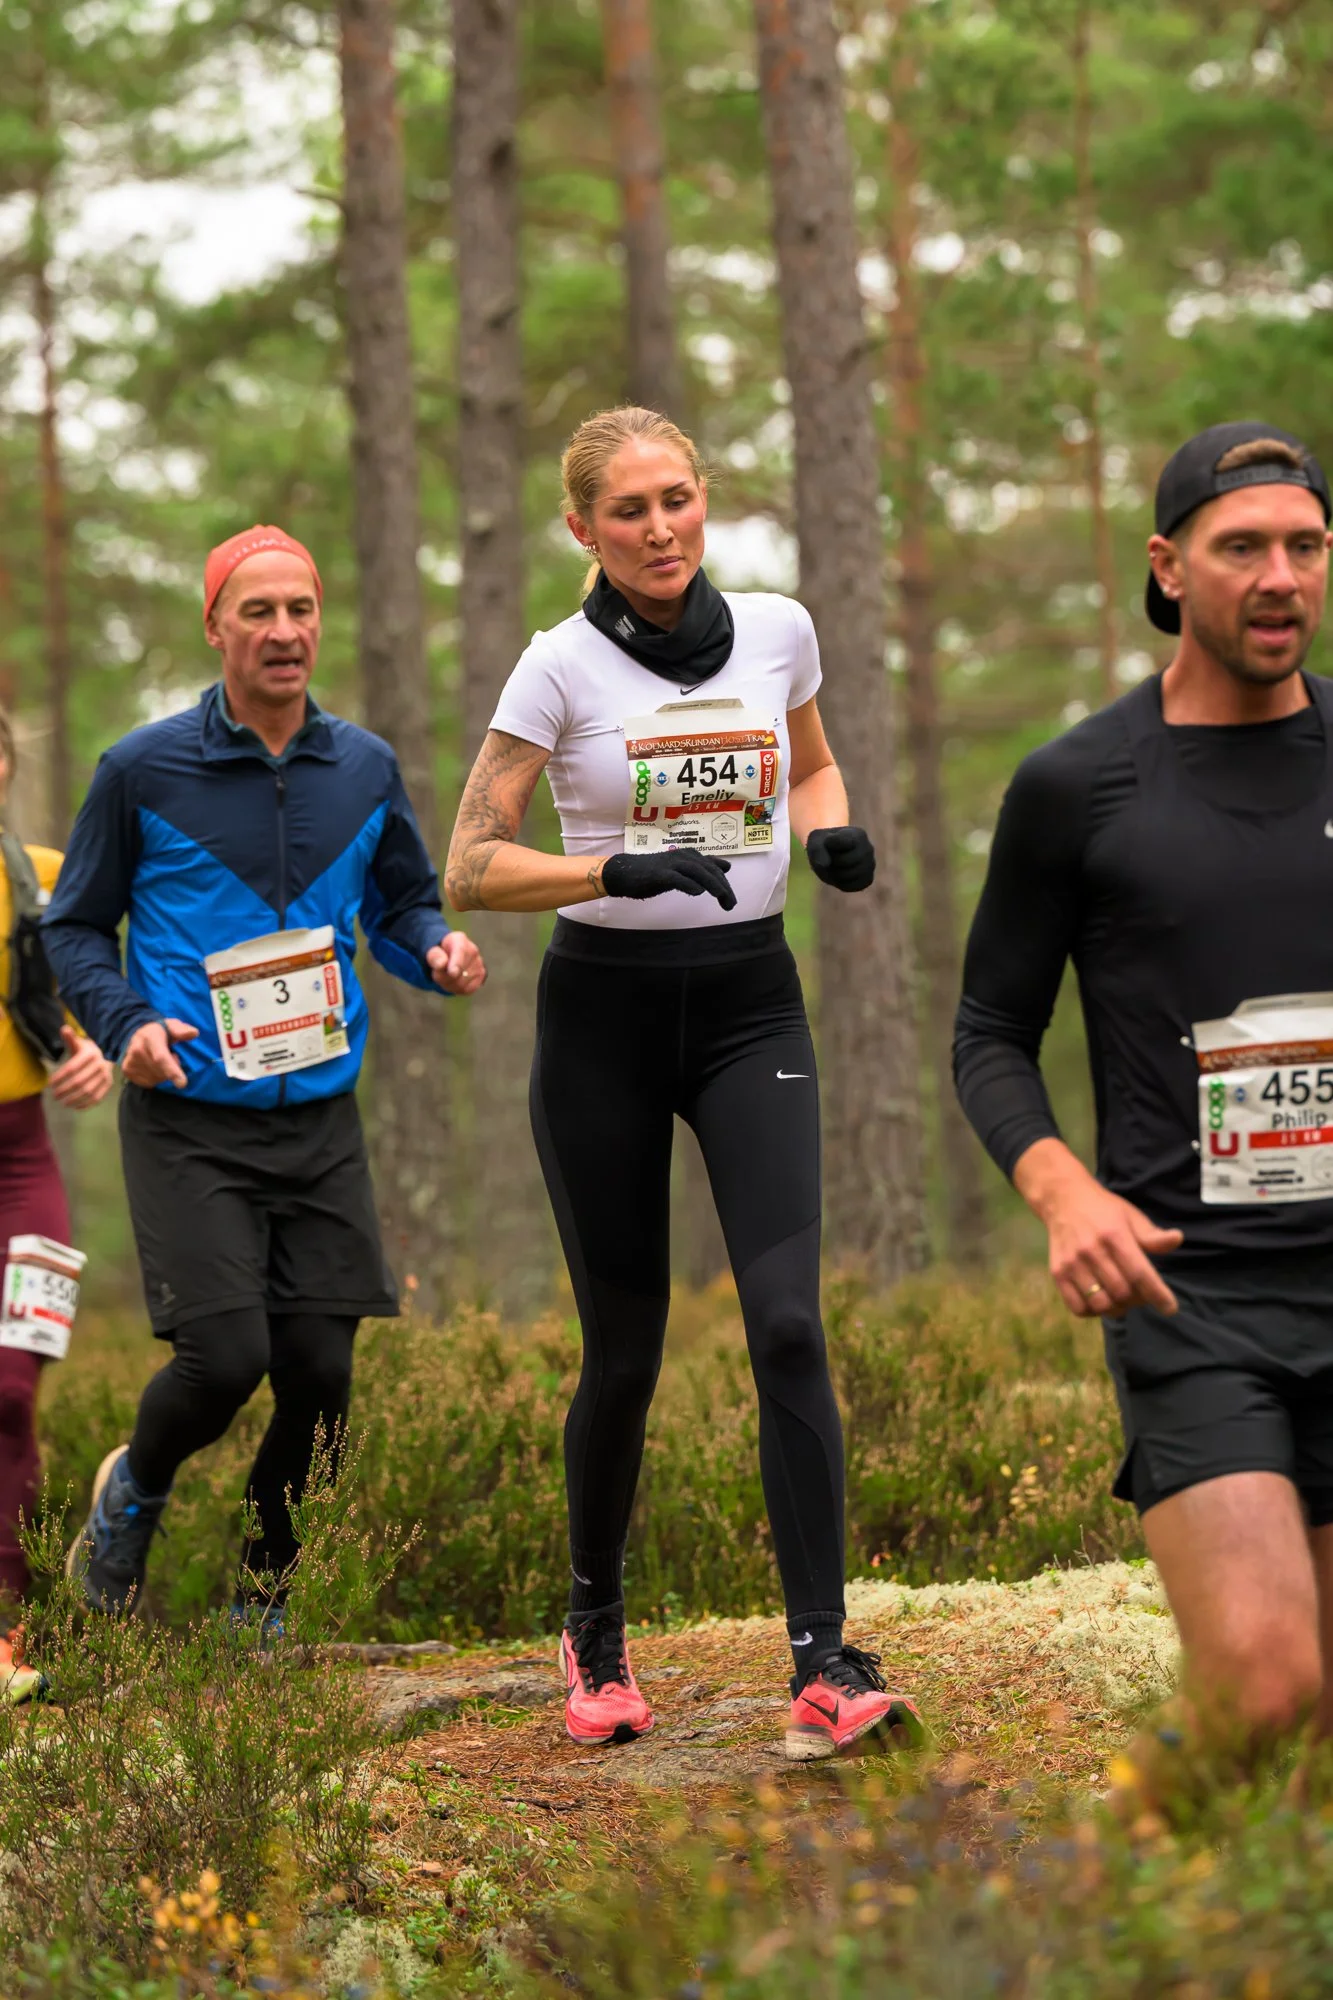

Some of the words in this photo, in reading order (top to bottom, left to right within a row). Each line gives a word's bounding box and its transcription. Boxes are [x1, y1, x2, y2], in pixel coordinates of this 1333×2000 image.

[636, 761, 650, 806] coop
[677, 755, 738, 788] 454
[764, 767, 772, 793] CIRCLE
[682, 789, 735, 806] Emeliy
[272, 979, 290, 1004] 3
[1261, 1068, 1333, 1107] 455
[1272, 1109, 1328, 1130] Philip
